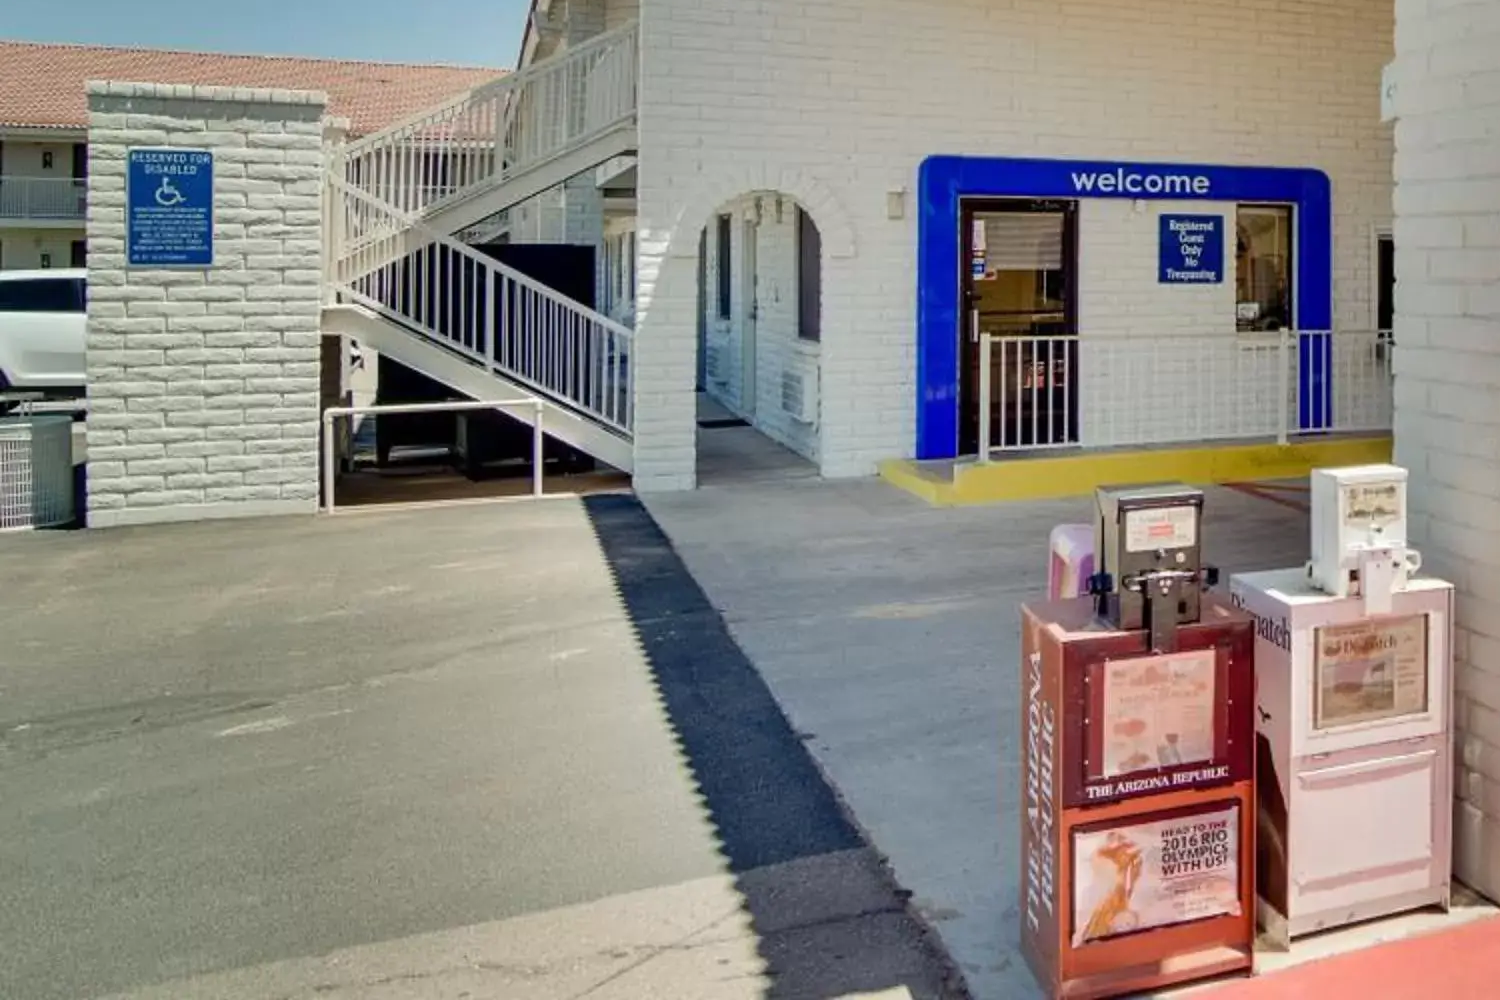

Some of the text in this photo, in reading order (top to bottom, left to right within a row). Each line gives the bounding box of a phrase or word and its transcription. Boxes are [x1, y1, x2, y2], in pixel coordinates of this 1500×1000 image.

[132, 153, 211, 164] RESERVED FOR
[144, 163, 197, 175] DISABLED
[1071, 167, 1210, 194] welcome
[1169, 220, 1214, 232] Registered
[1181, 244, 1203, 257] Only
[1185, 256, 1198, 268] No
[1166, 268, 1217, 281] Trespassing
[1086, 765, 1230, 799] THE ARIZONA REPUBLIC
[1028, 651, 1041, 933] THE ARIZONA
[1041, 700, 1054, 918] REPUBLIC
[1161, 819, 1227, 837] HEAD TO THE
[1161, 829, 1228, 852] 2016 RIO
[1161, 842, 1228, 863] OLYMPICS
[1161, 854, 1227, 876] WITH US!
